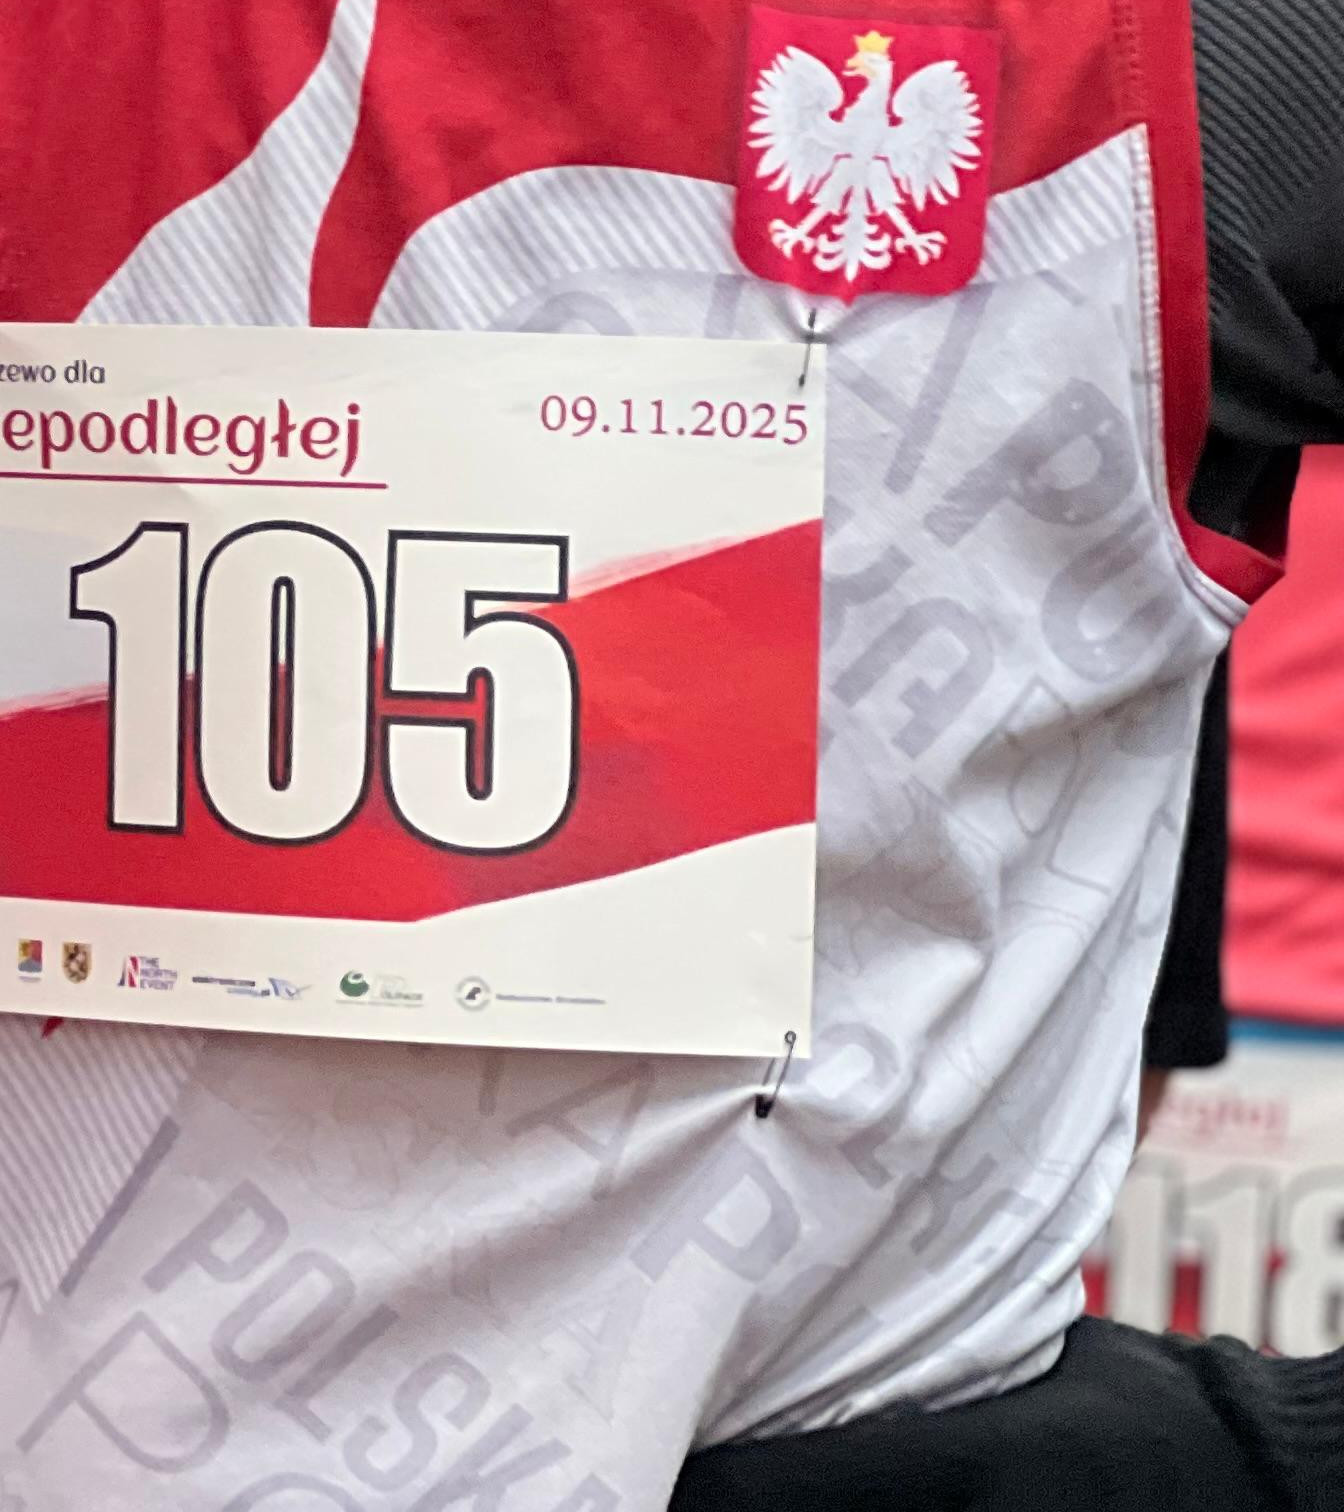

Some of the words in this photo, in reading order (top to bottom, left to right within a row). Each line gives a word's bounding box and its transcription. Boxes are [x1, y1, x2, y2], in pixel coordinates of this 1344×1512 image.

[64, 359, 106, 384] dla
[540, 394, 808, 445] 09.11.2025
[69, 519, 579, 856] 105
[143, 1178, 624, 1512] POLSK
